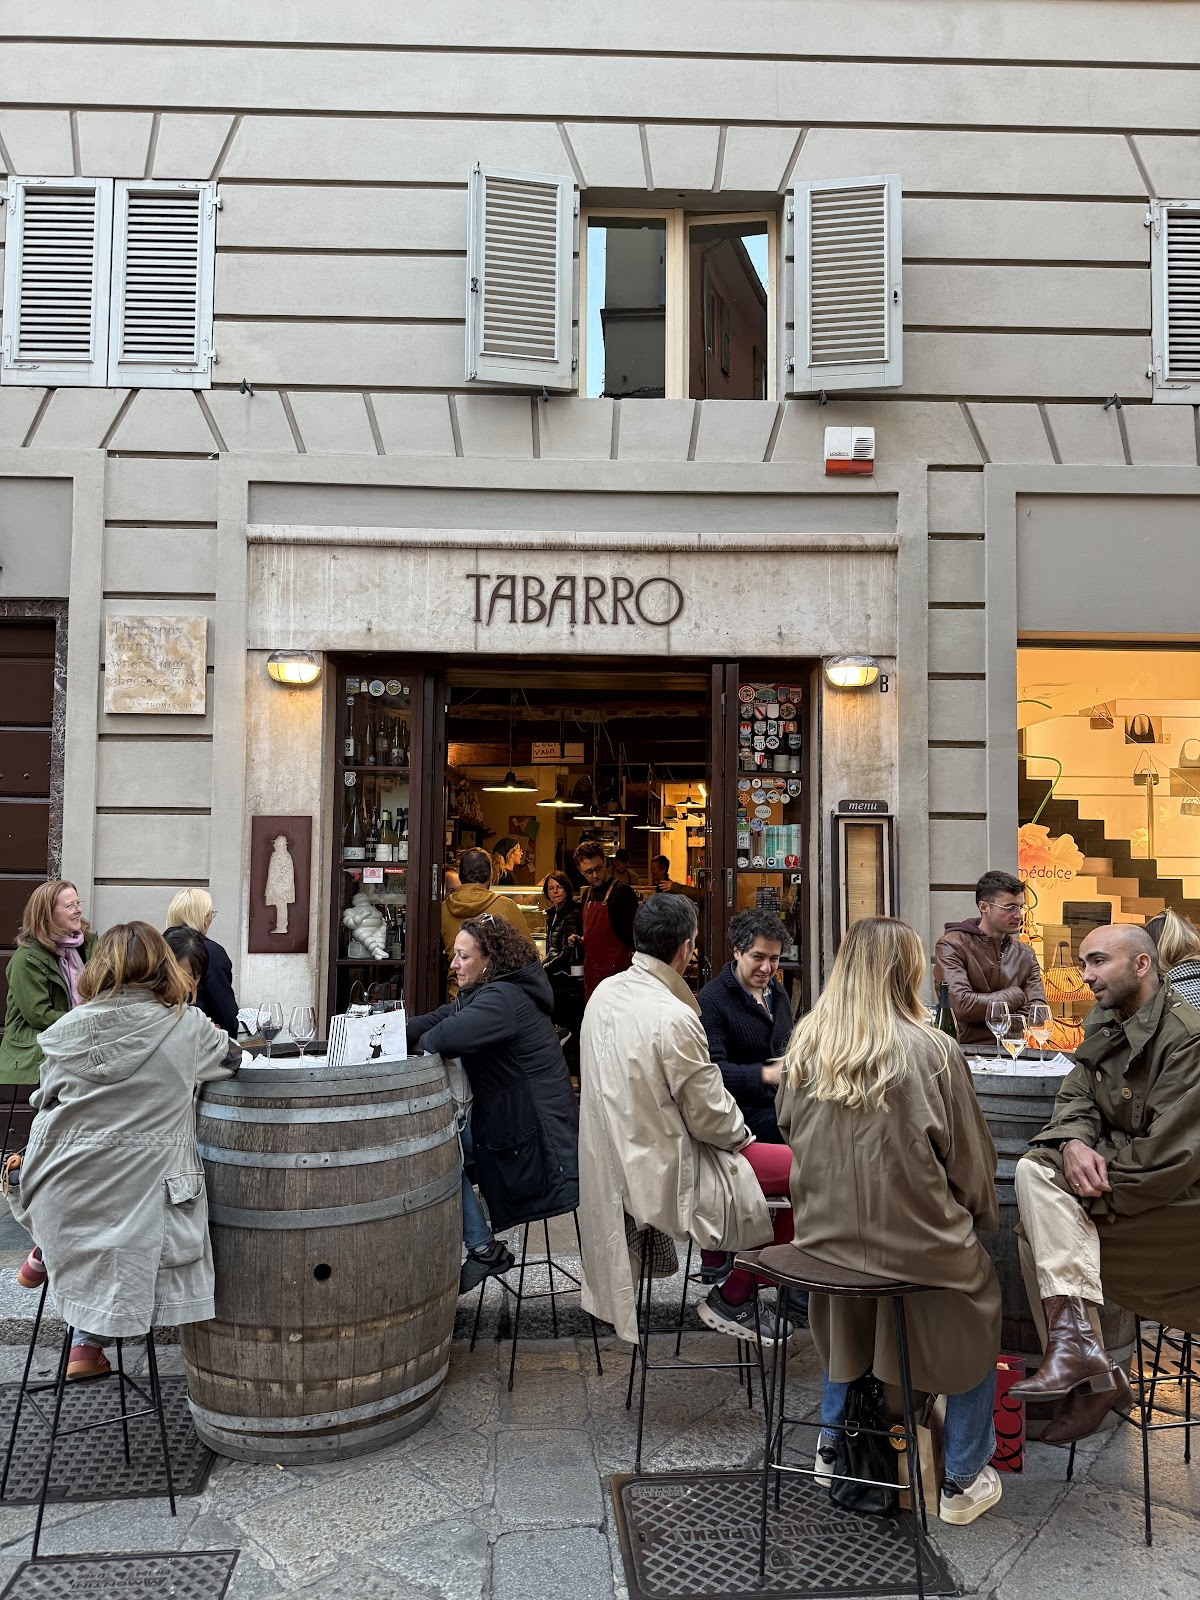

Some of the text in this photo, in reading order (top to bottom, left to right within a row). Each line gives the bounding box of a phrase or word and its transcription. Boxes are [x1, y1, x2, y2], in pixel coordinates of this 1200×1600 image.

[465, 573, 684, 626] TABARRO
[880, 674, 889, 693] B
[848, 802, 878, 810] menu
[679, 1527, 746, 1543] PARMA
[781, 1521, 861, 1538] COMUNE
